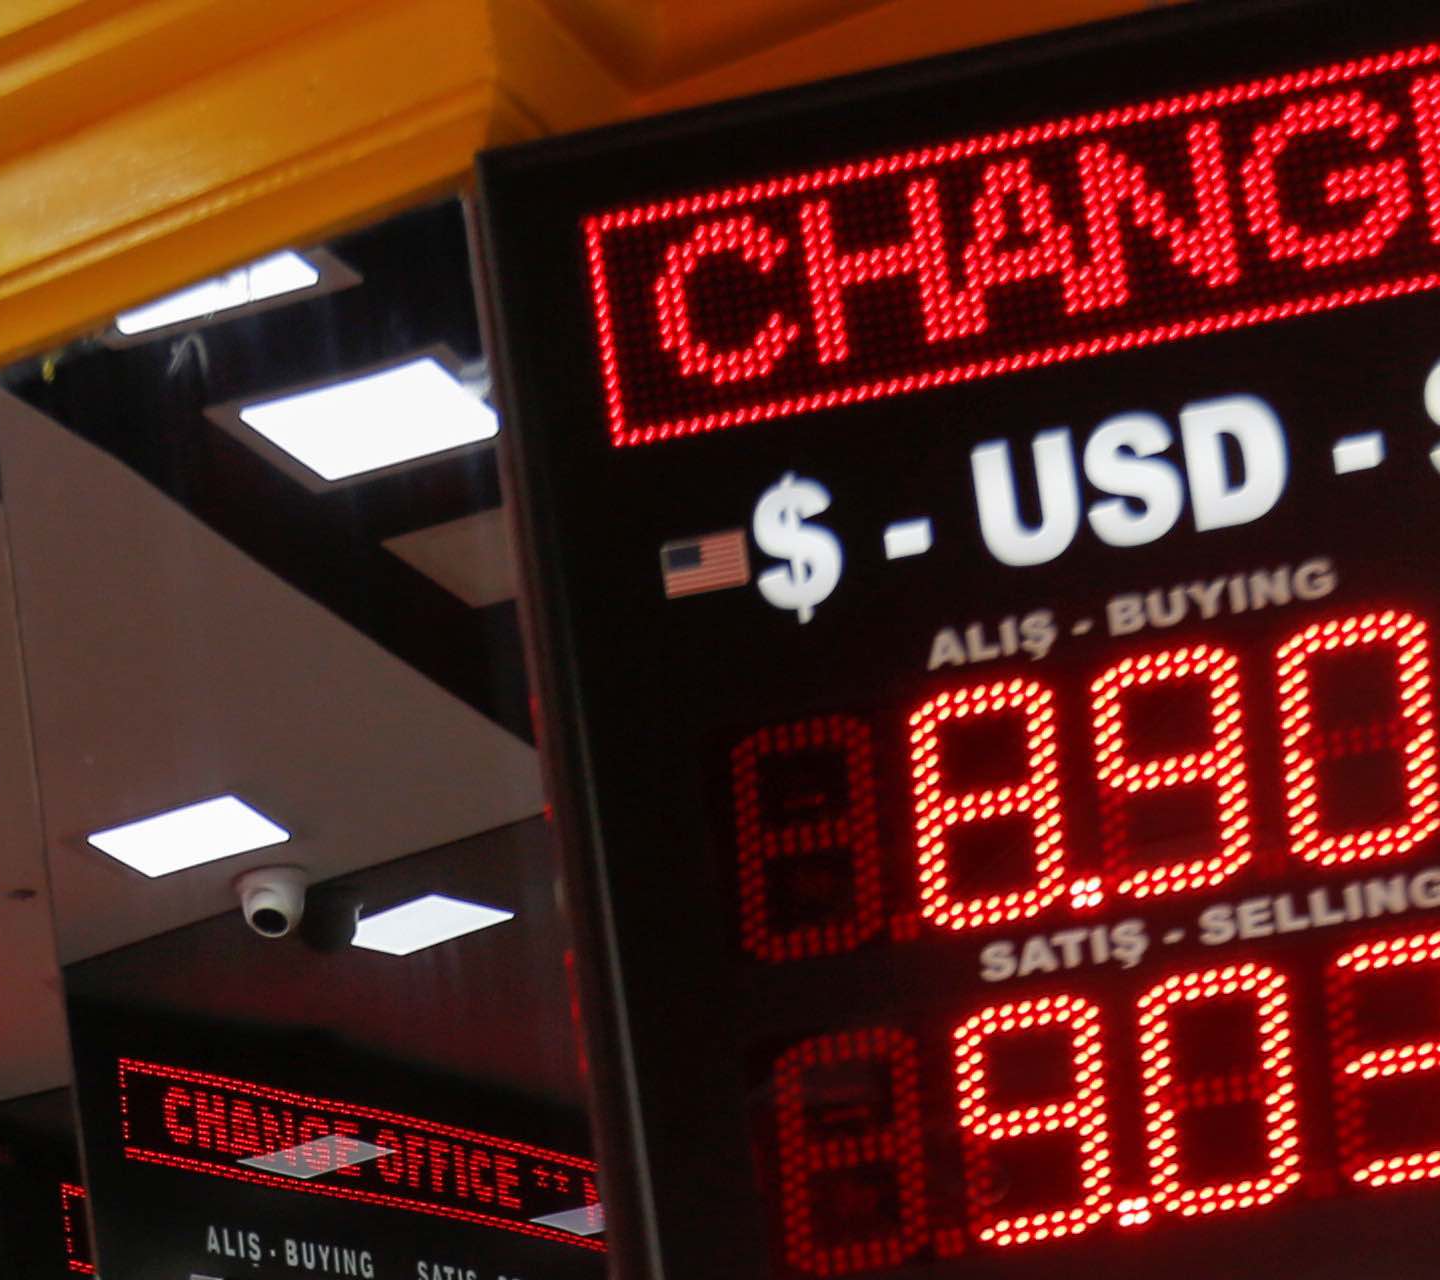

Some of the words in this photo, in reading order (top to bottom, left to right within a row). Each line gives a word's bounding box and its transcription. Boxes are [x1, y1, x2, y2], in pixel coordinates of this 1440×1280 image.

[753, 471, 844, 624] $
[971, 394, 1288, 569] USD
[928, 607, 1058, 671] ALIŞ
[1107, 559, 1338, 636] BUYING
[981, 917, 1147, 983] SATIŞ
[370, 1128, 523, 1210] OFFICE
[285, 1242, 374, 1280] BUYING
